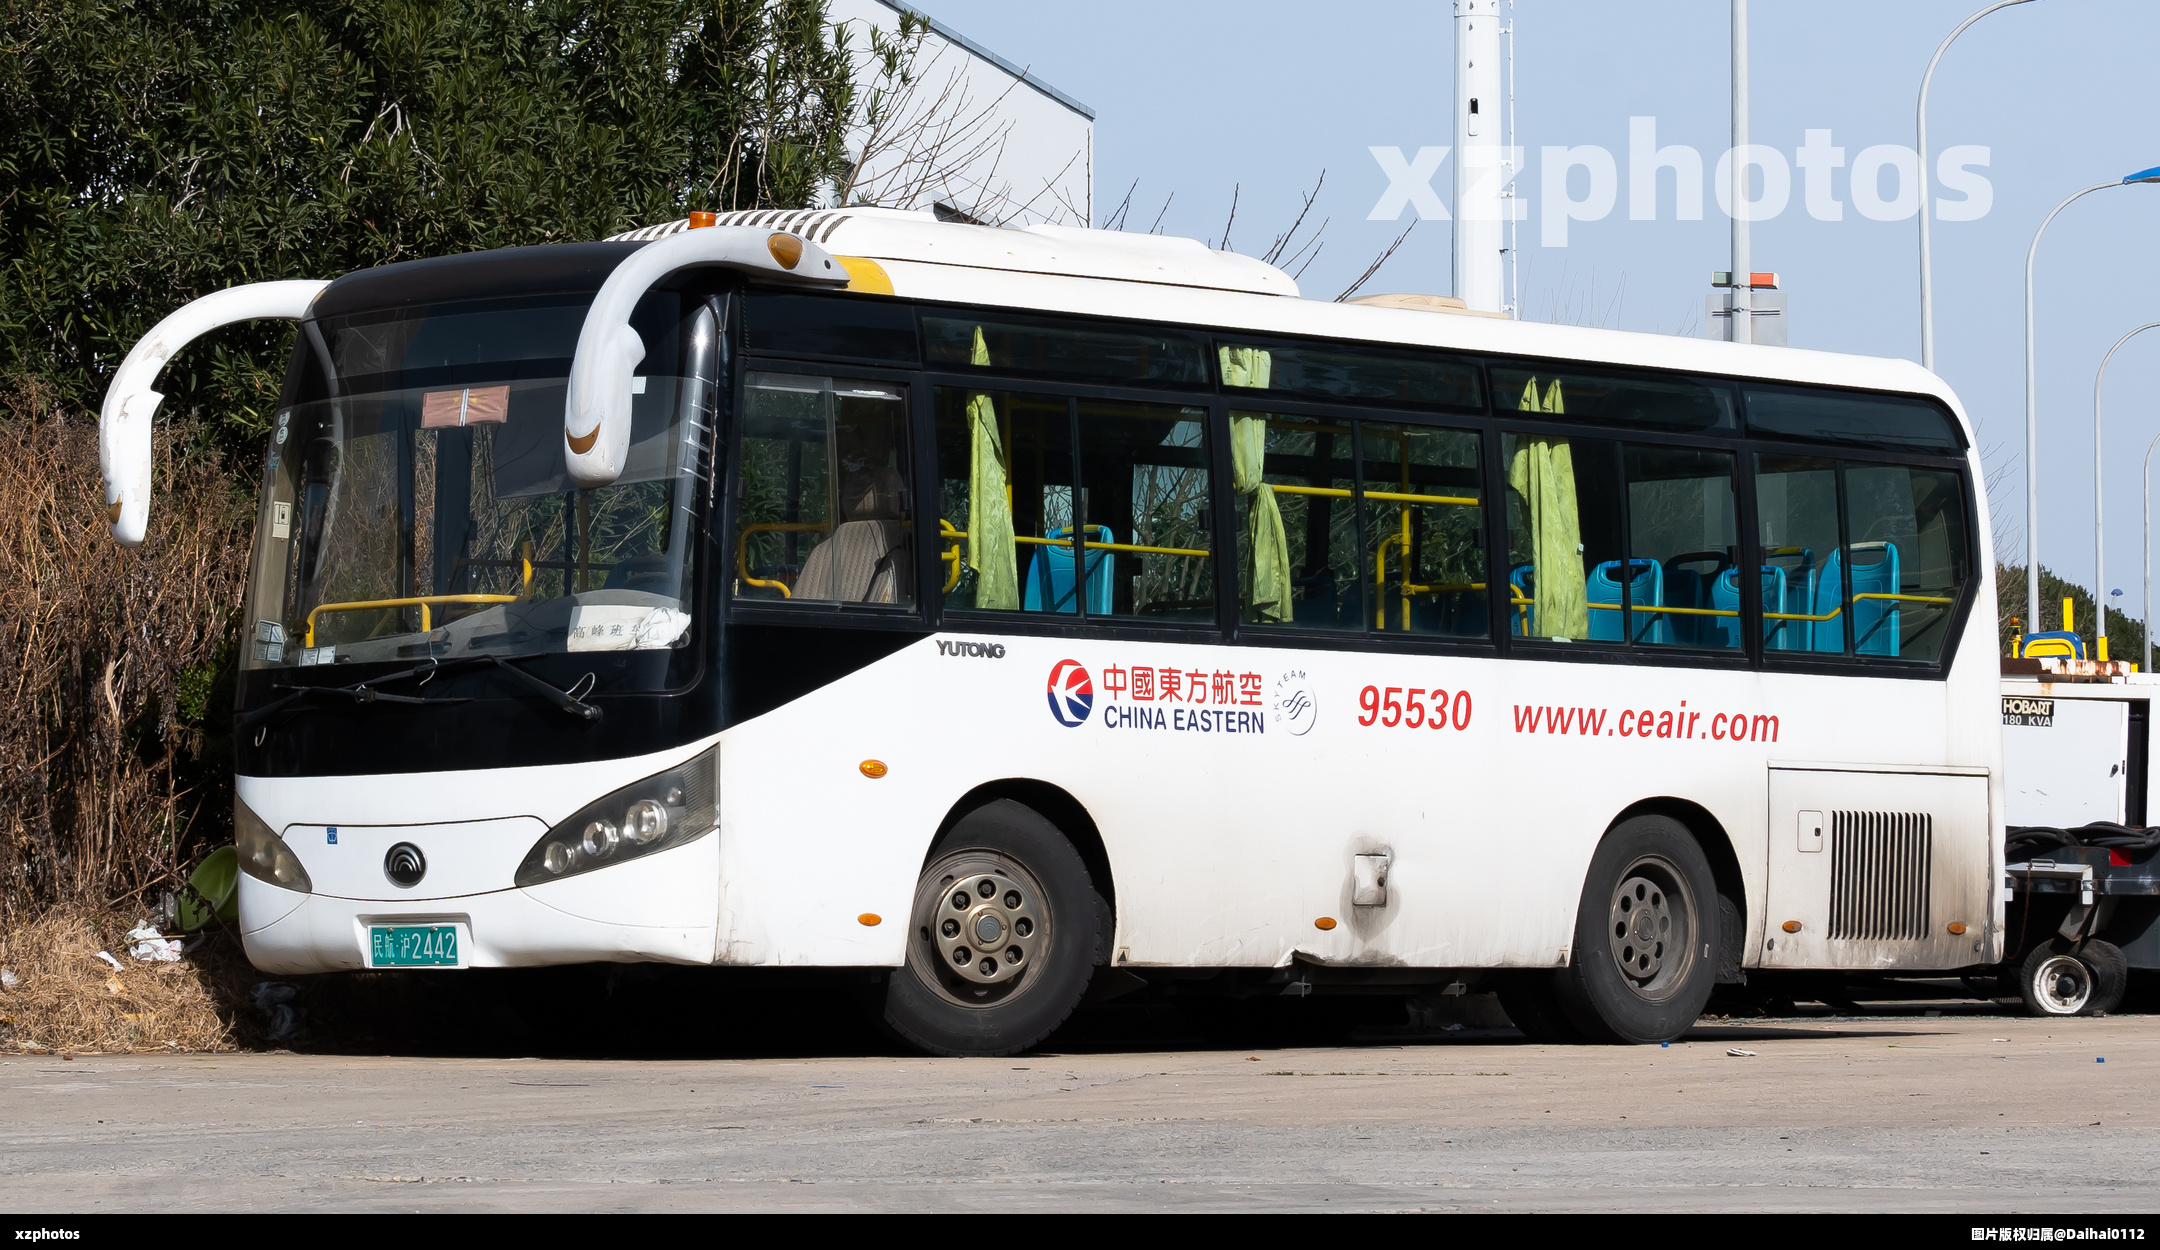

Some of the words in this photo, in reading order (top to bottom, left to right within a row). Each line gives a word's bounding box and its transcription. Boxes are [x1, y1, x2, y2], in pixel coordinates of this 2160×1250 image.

[936, 640, 1006, 658] YUTONG
[1103, 663, 1262, 705] 中國東方航空
[1273, 670, 1306, 722] SKYTEAM
[1104, 705, 1167, 730] CHINA
[1174, 709, 1264, 734] EASTERN
[1358, 685, 1472, 731] 95530
[1513, 700, 1780, 742] www.ceair.com
[2003, 699, 2052, 715] HOBART
[2003, 715, 2022, 725] 180
[2029, 716, 2051, 727] KVA
